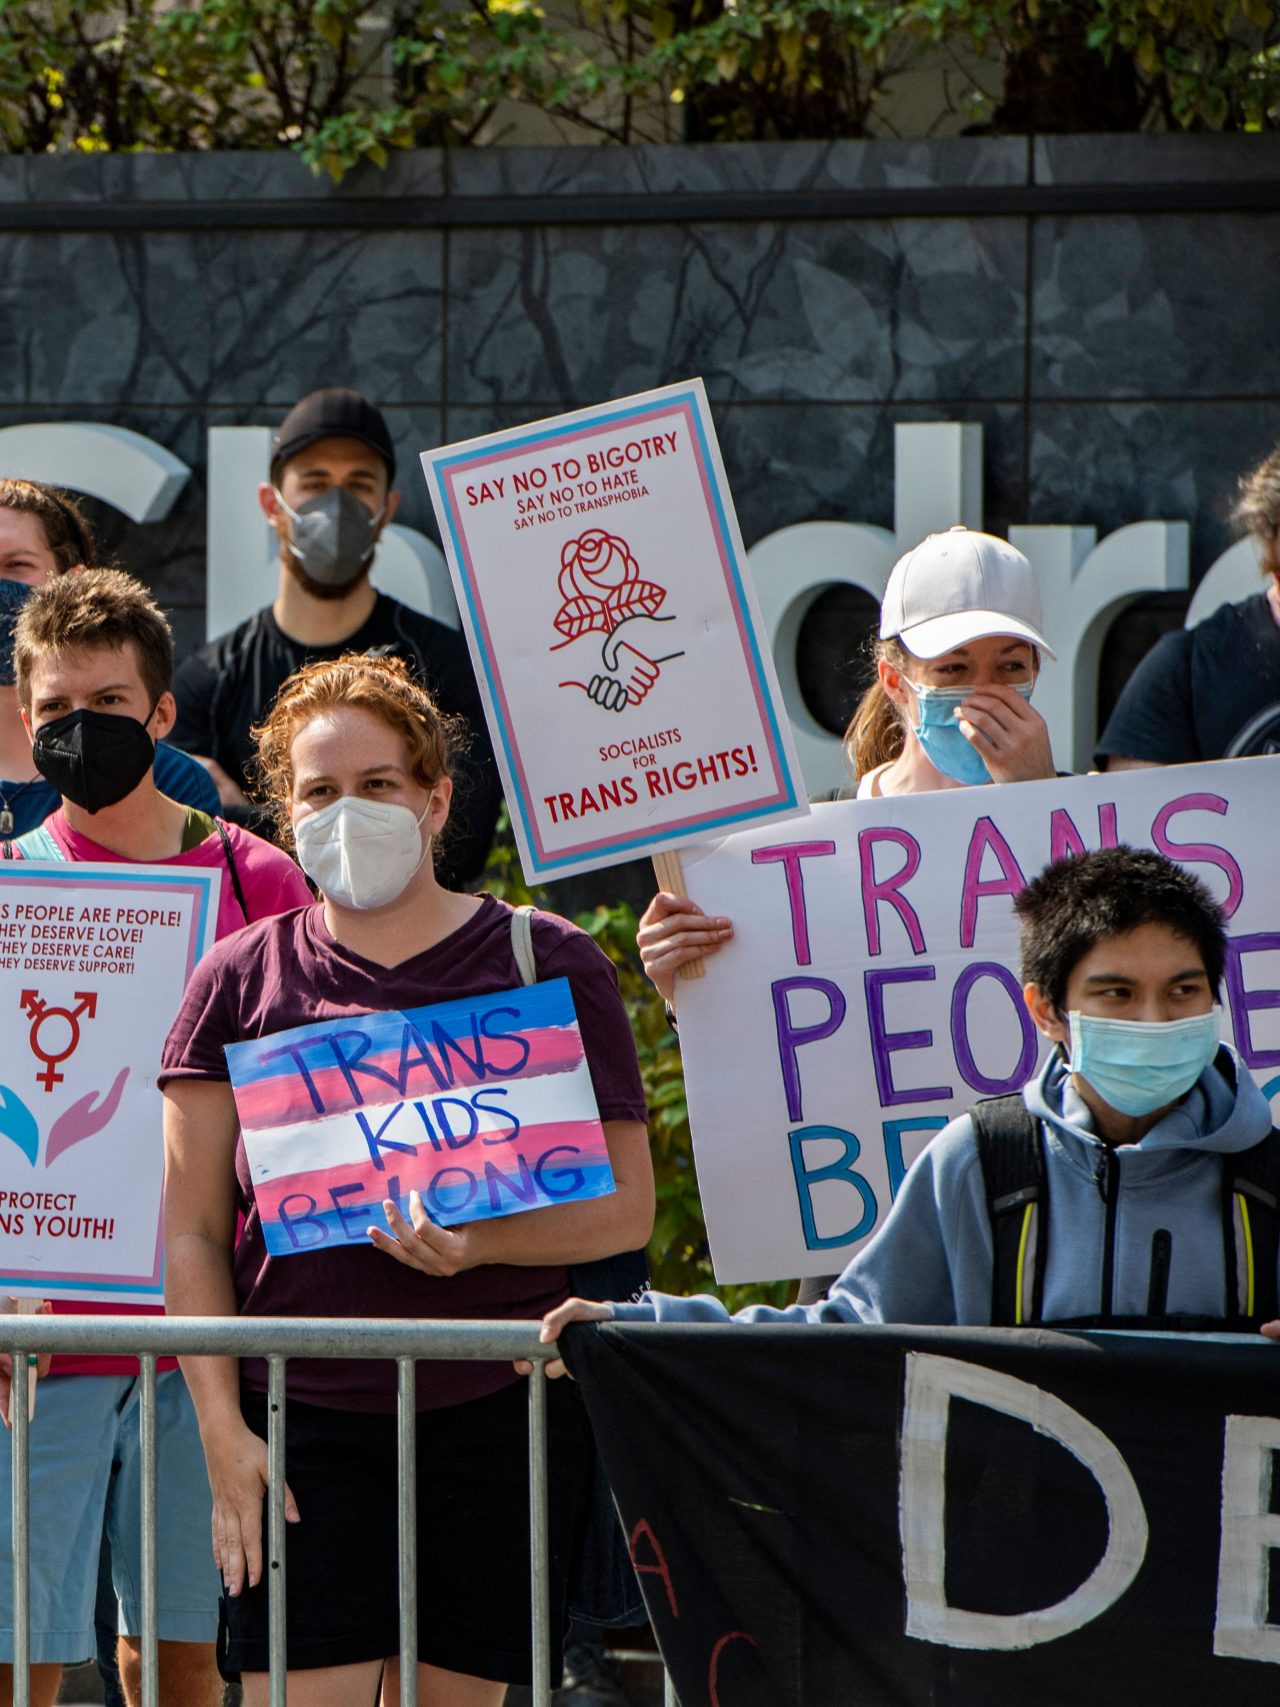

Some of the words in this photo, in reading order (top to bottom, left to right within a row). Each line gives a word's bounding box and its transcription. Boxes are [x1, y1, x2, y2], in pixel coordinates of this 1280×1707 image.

[466, 477, 505, 506] SAY
[513, 468, 547, 494] NO
[552, 459, 580, 482] TO
[587, 431, 678, 474] BIGOTRY
[514, 515, 534, 530] SAY
[538, 510, 555, 523] NO
[558, 507, 572, 518] TO
[575, 486, 650, 514] TRANSPHOBIA
[517, 494, 545, 514] SAY
[550, 486, 574, 506] NO
[577, 480, 597, 499] TO
[602, 469, 639, 492] HATE
[599, 728, 682, 761] SOCIALISTS
[633, 753, 657, 769] FOR
[544, 776, 638, 824] TRANS
[645, 745, 758, 799] RIGHTS!
[15, 905, 74, 922] PEOPLE
[79, 908, 110, 924] ARE
[116, 908, 181, 927] PEOPLE!
[31, 924, 95, 941] DESERVE
[99, 927, 143, 943] LOVE!
[24, 958, 75, 972] DESERVE
[79, 960, 135, 975] SUPPORT!
[32, 943, 89, 957] DESERVE
[93, 945, 135, 959] CARE!
[257, 1007, 530, 1114] TRANS
[356, 1087, 520, 1171] KIDS
[33, 1215, 115, 1240] YOUTH!
